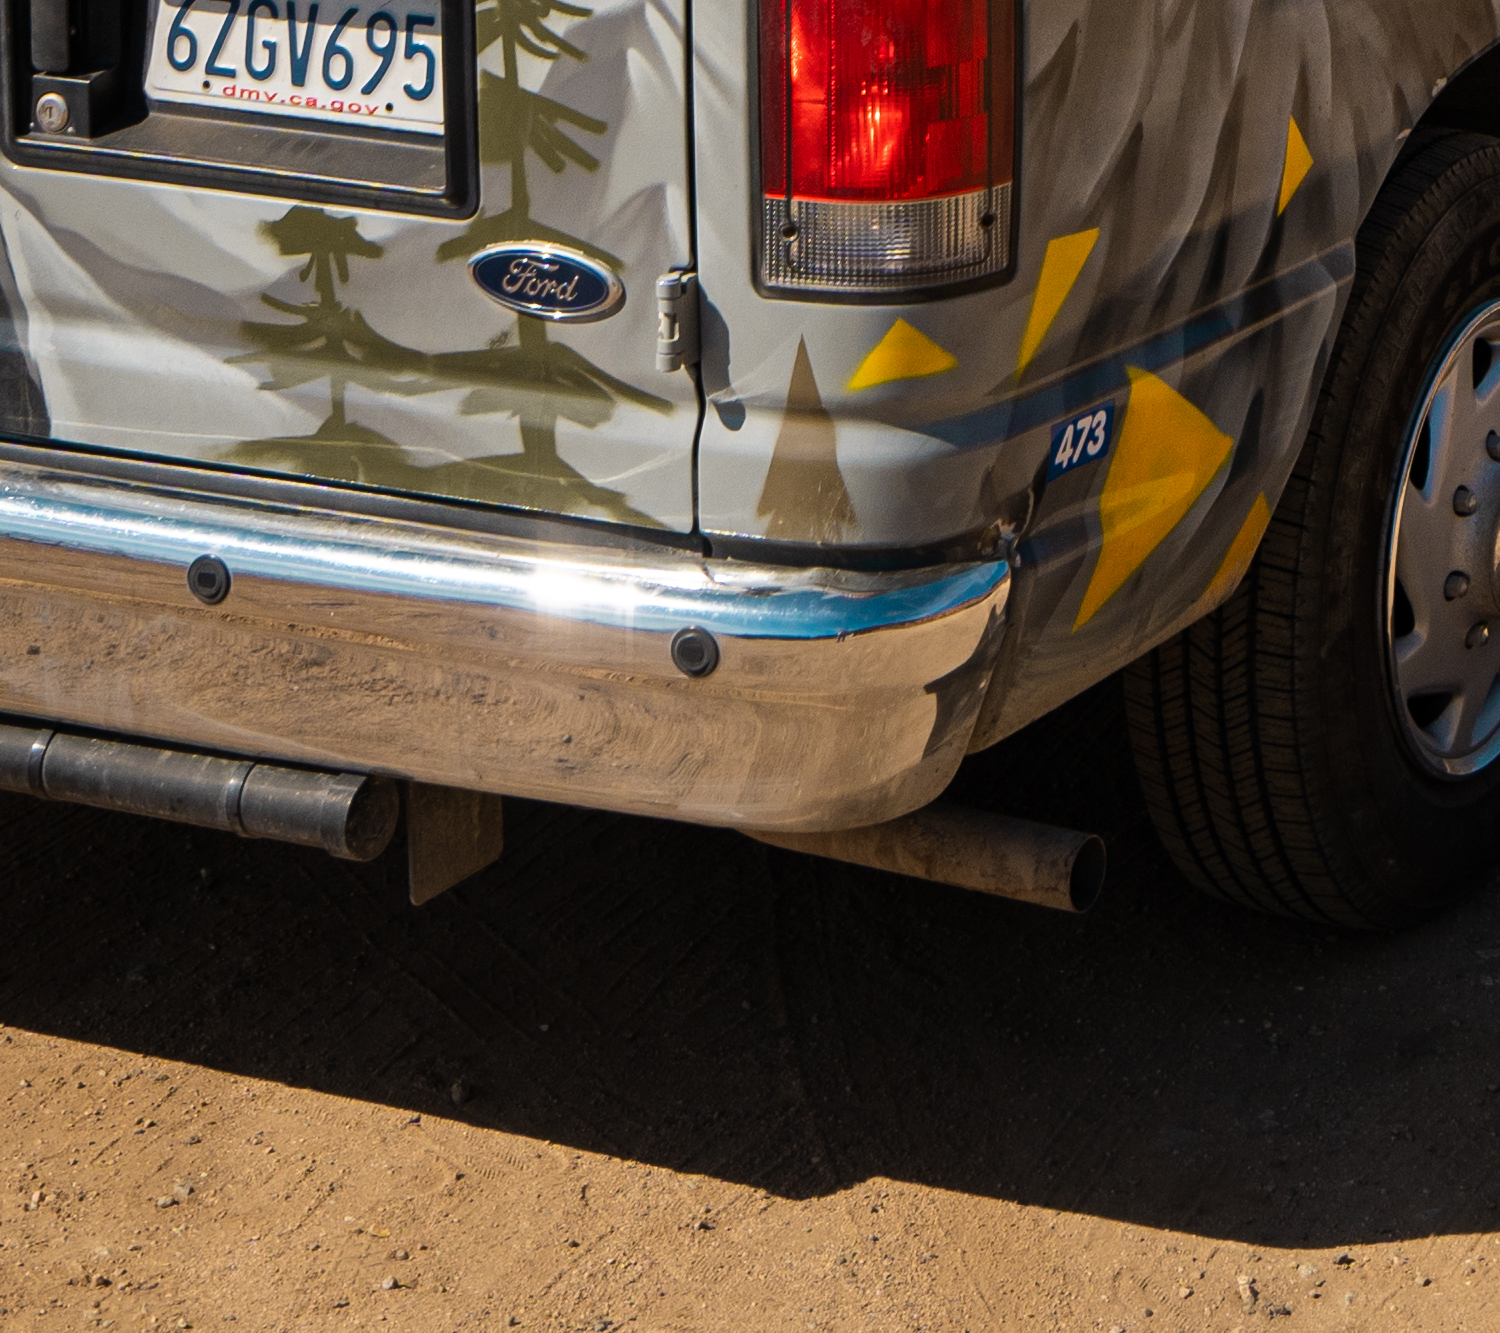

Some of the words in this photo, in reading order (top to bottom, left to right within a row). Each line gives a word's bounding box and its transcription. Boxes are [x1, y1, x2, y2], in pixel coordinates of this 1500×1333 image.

[222, 85, 380, 115] dmv.ca.gov
[500, 263, 581, 303] Ford
[1054, 409, 1107, 471] 473
